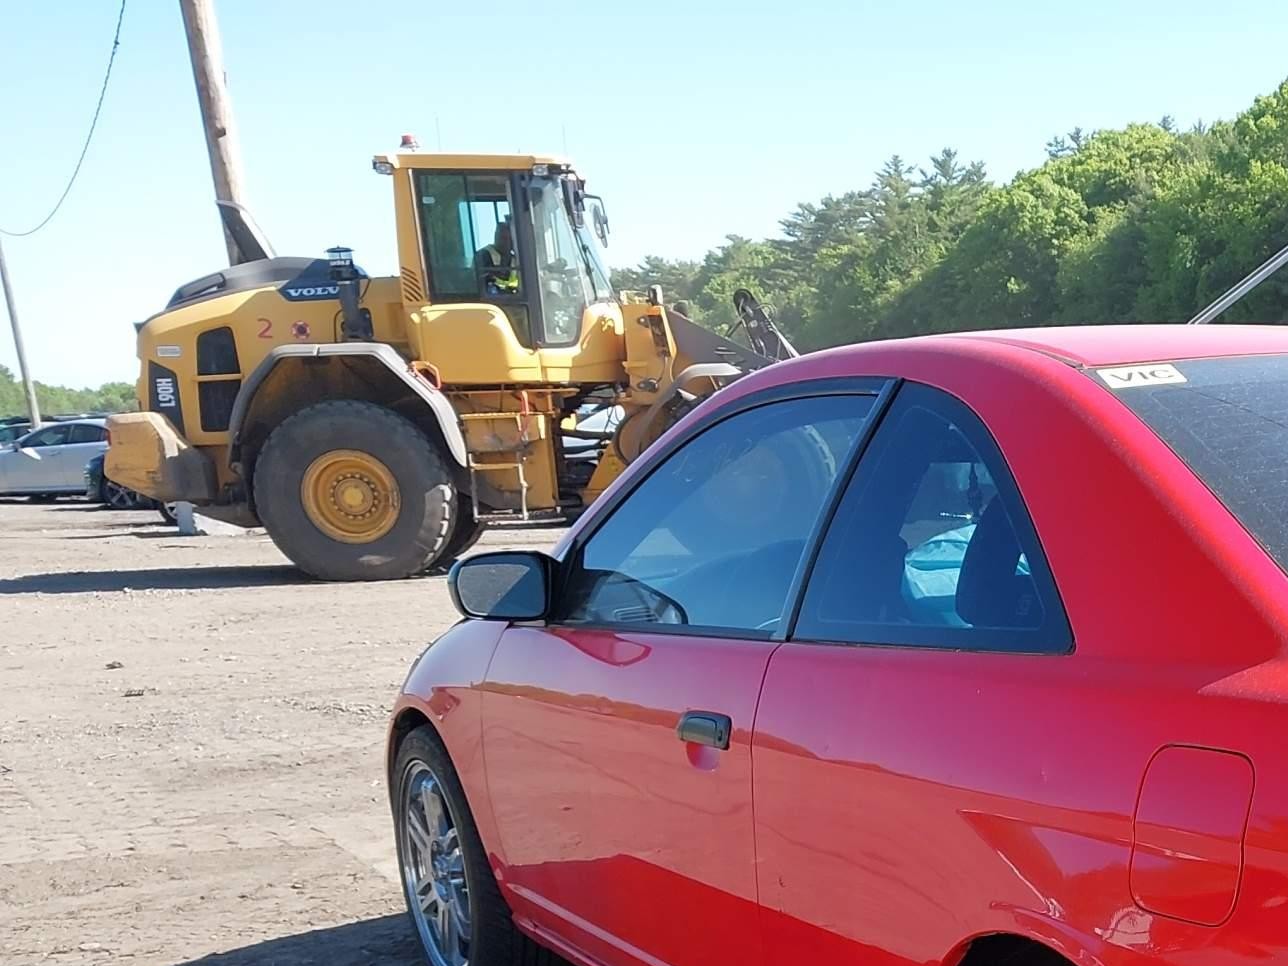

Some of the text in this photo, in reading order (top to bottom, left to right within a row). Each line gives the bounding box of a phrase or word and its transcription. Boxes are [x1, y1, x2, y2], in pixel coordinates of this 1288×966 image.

[286, 286, 340, 297] VOLV
[257, 318, 273, 339] 2
[155, 378, 176, 407] L90H
